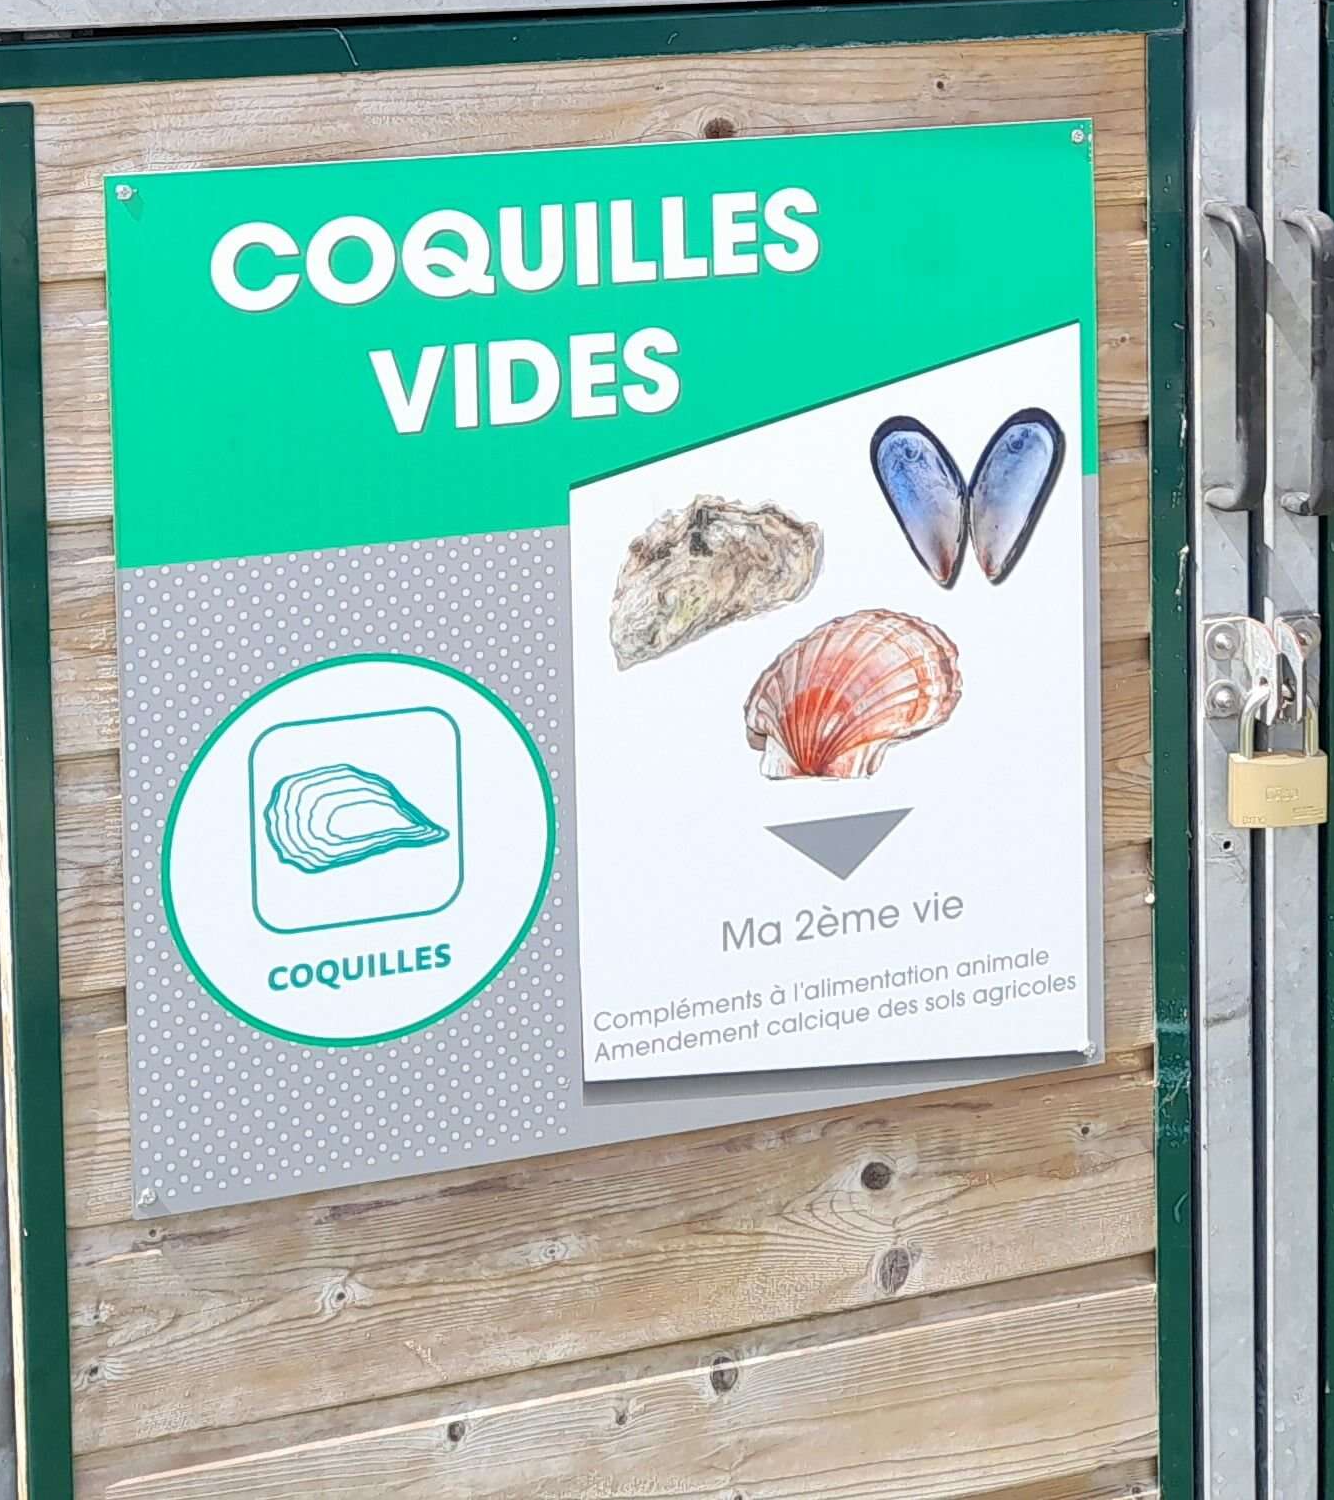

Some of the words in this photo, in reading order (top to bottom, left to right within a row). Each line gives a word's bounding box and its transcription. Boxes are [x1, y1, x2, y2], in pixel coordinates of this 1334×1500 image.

[210, 187, 819, 311] COQUILLES
[368, 327, 680, 433] VIDES
[722, 917, 782, 952] Ma
[795, 904, 900, 942] 2ème
[912, 891, 964, 924] vie
[267, 943, 452, 992] COQUILLES
[593, 989, 763, 1032] Compléments
[769, 984, 786, 1006] à
[794, 964, 949, 1002] l'alimentation
[956, 947, 1049, 978] animale
[594, 1019, 760, 1063] Amendement
[766, 1006, 869, 1036] calcique
[877, 998, 919, 1019] des
[925, 988, 966, 1012] sols
[972, 974, 1076, 1007] agricoles
